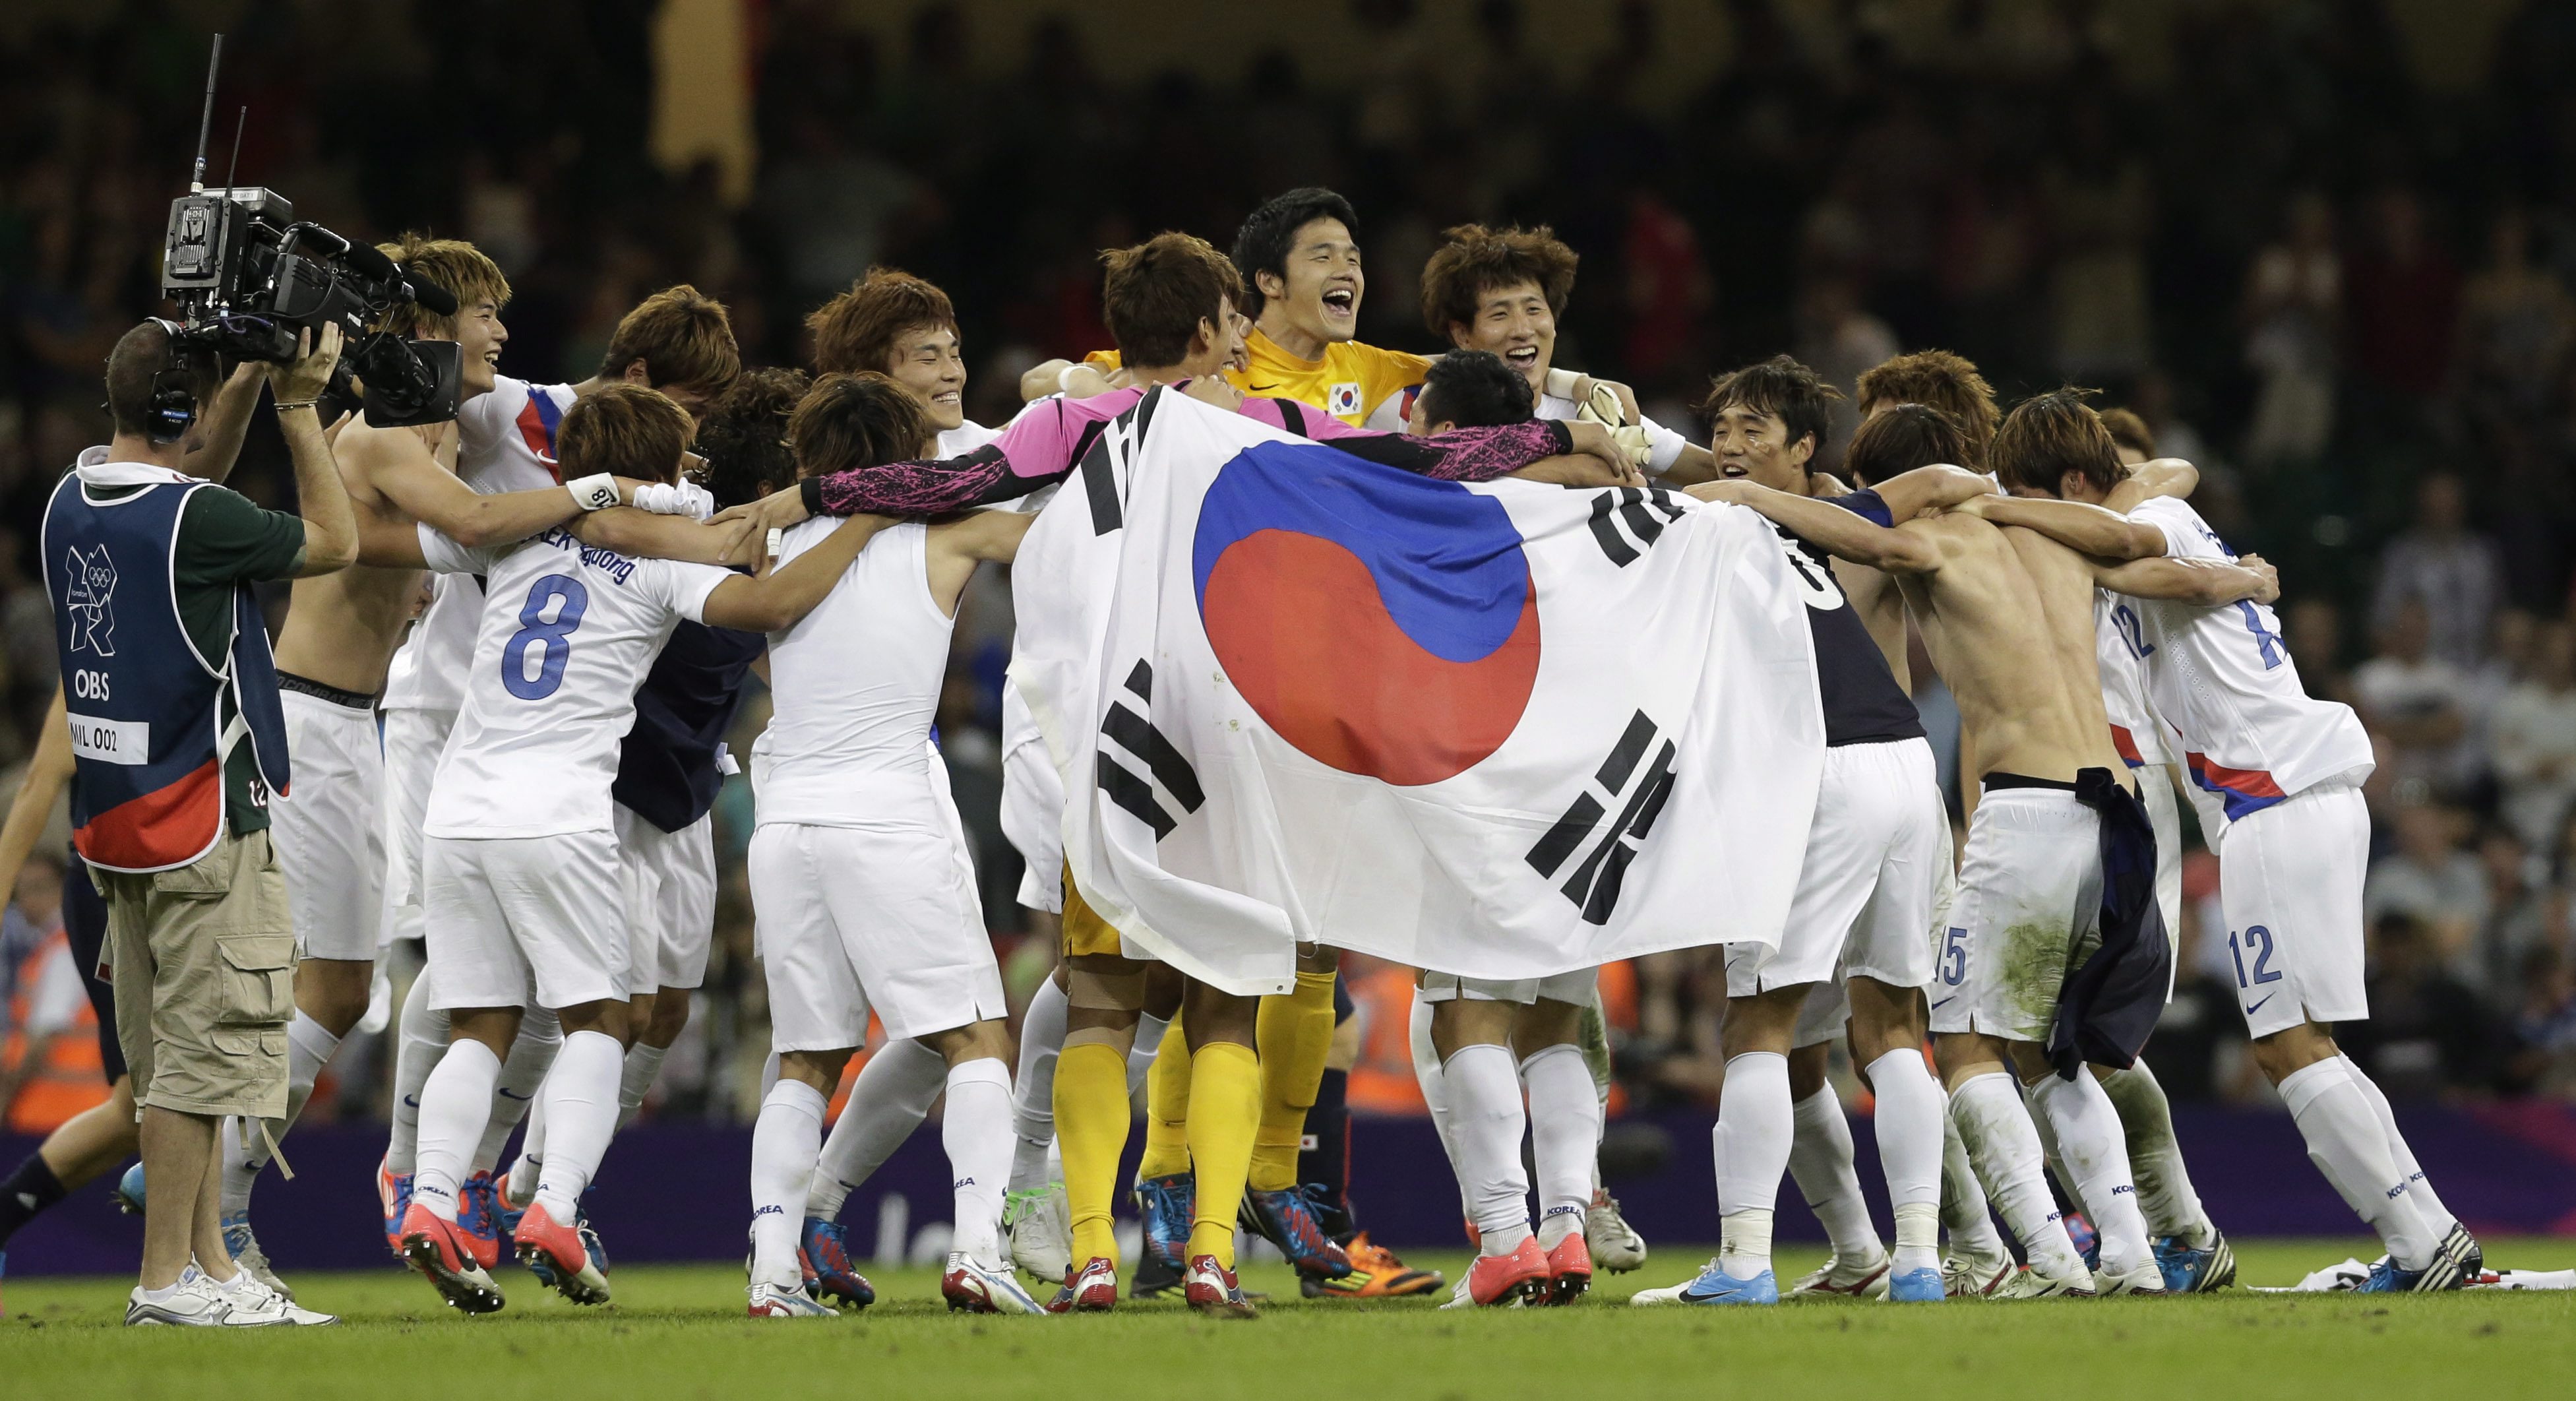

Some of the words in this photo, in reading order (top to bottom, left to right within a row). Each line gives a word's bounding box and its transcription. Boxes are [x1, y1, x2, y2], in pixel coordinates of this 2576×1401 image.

[501, 574, 588, 700] 8
[2110, 605, 2156, 661] 12
[75, 668, 110, 701] OBS
[70, 722, 90, 747] MIL
[94, 727, 117, 752] 002
[2228, 925, 2283, 988] 12
[1547, 1205, 1581, 1219] KOREA
